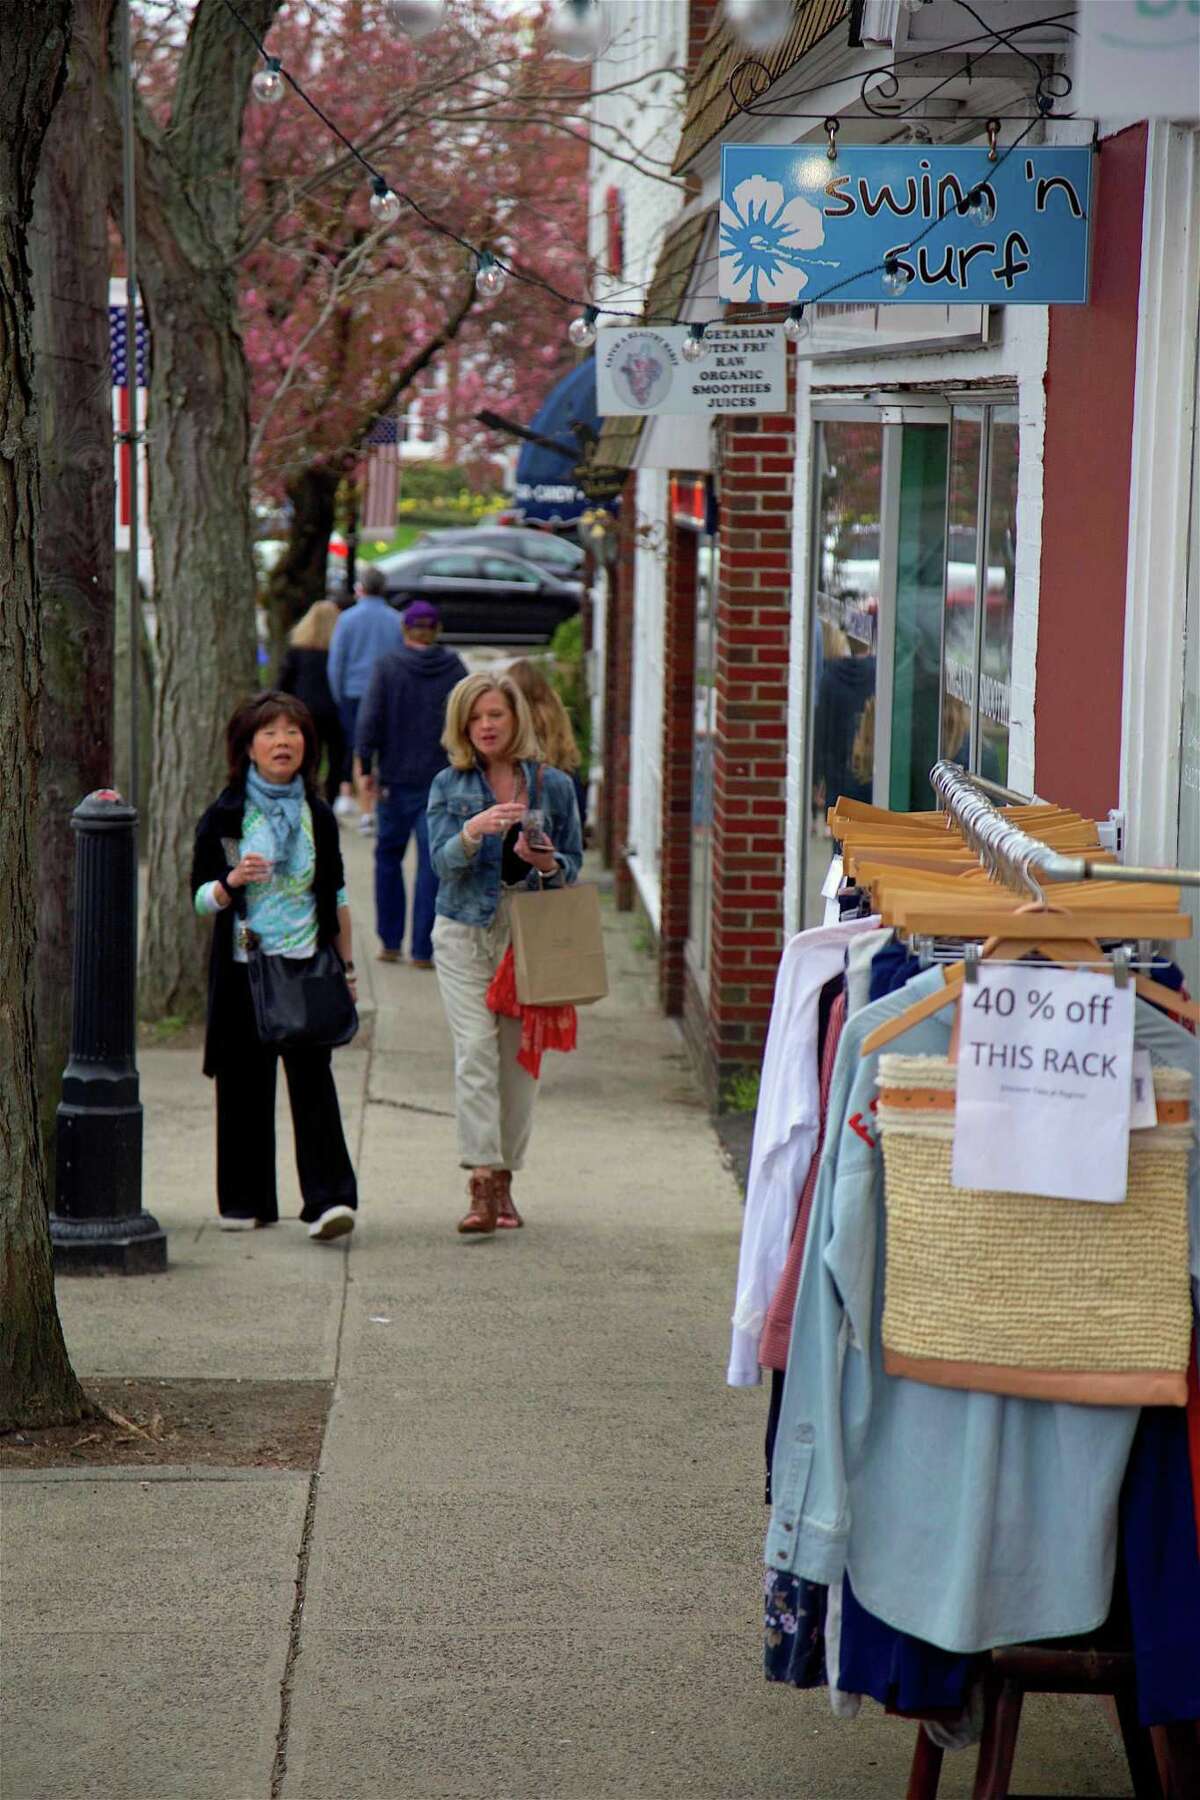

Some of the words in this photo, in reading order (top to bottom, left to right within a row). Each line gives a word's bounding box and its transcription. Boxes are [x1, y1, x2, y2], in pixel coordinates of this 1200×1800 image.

[823, 159, 996, 221] swim
[1024, 159, 1083, 218] 'n
[883, 230, 1030, 289] surf
[688, 328, 776, 340] GETARIAN
[716, 357, 746, 367] RAW
[699, 370, 764, 381] ORGANIC
[692, 383, 772, 394] SMOOTHIES
[707, 397, 757, 408] JUICES
[973, 987, 1016, 1017] 40
[1027, 989, 1055, 1021] %
[1066, 994, 1114, 1026] off
[970, 1042, 1034, 1070] THIS
[1043, 1048, 1118, 1080] RACK
